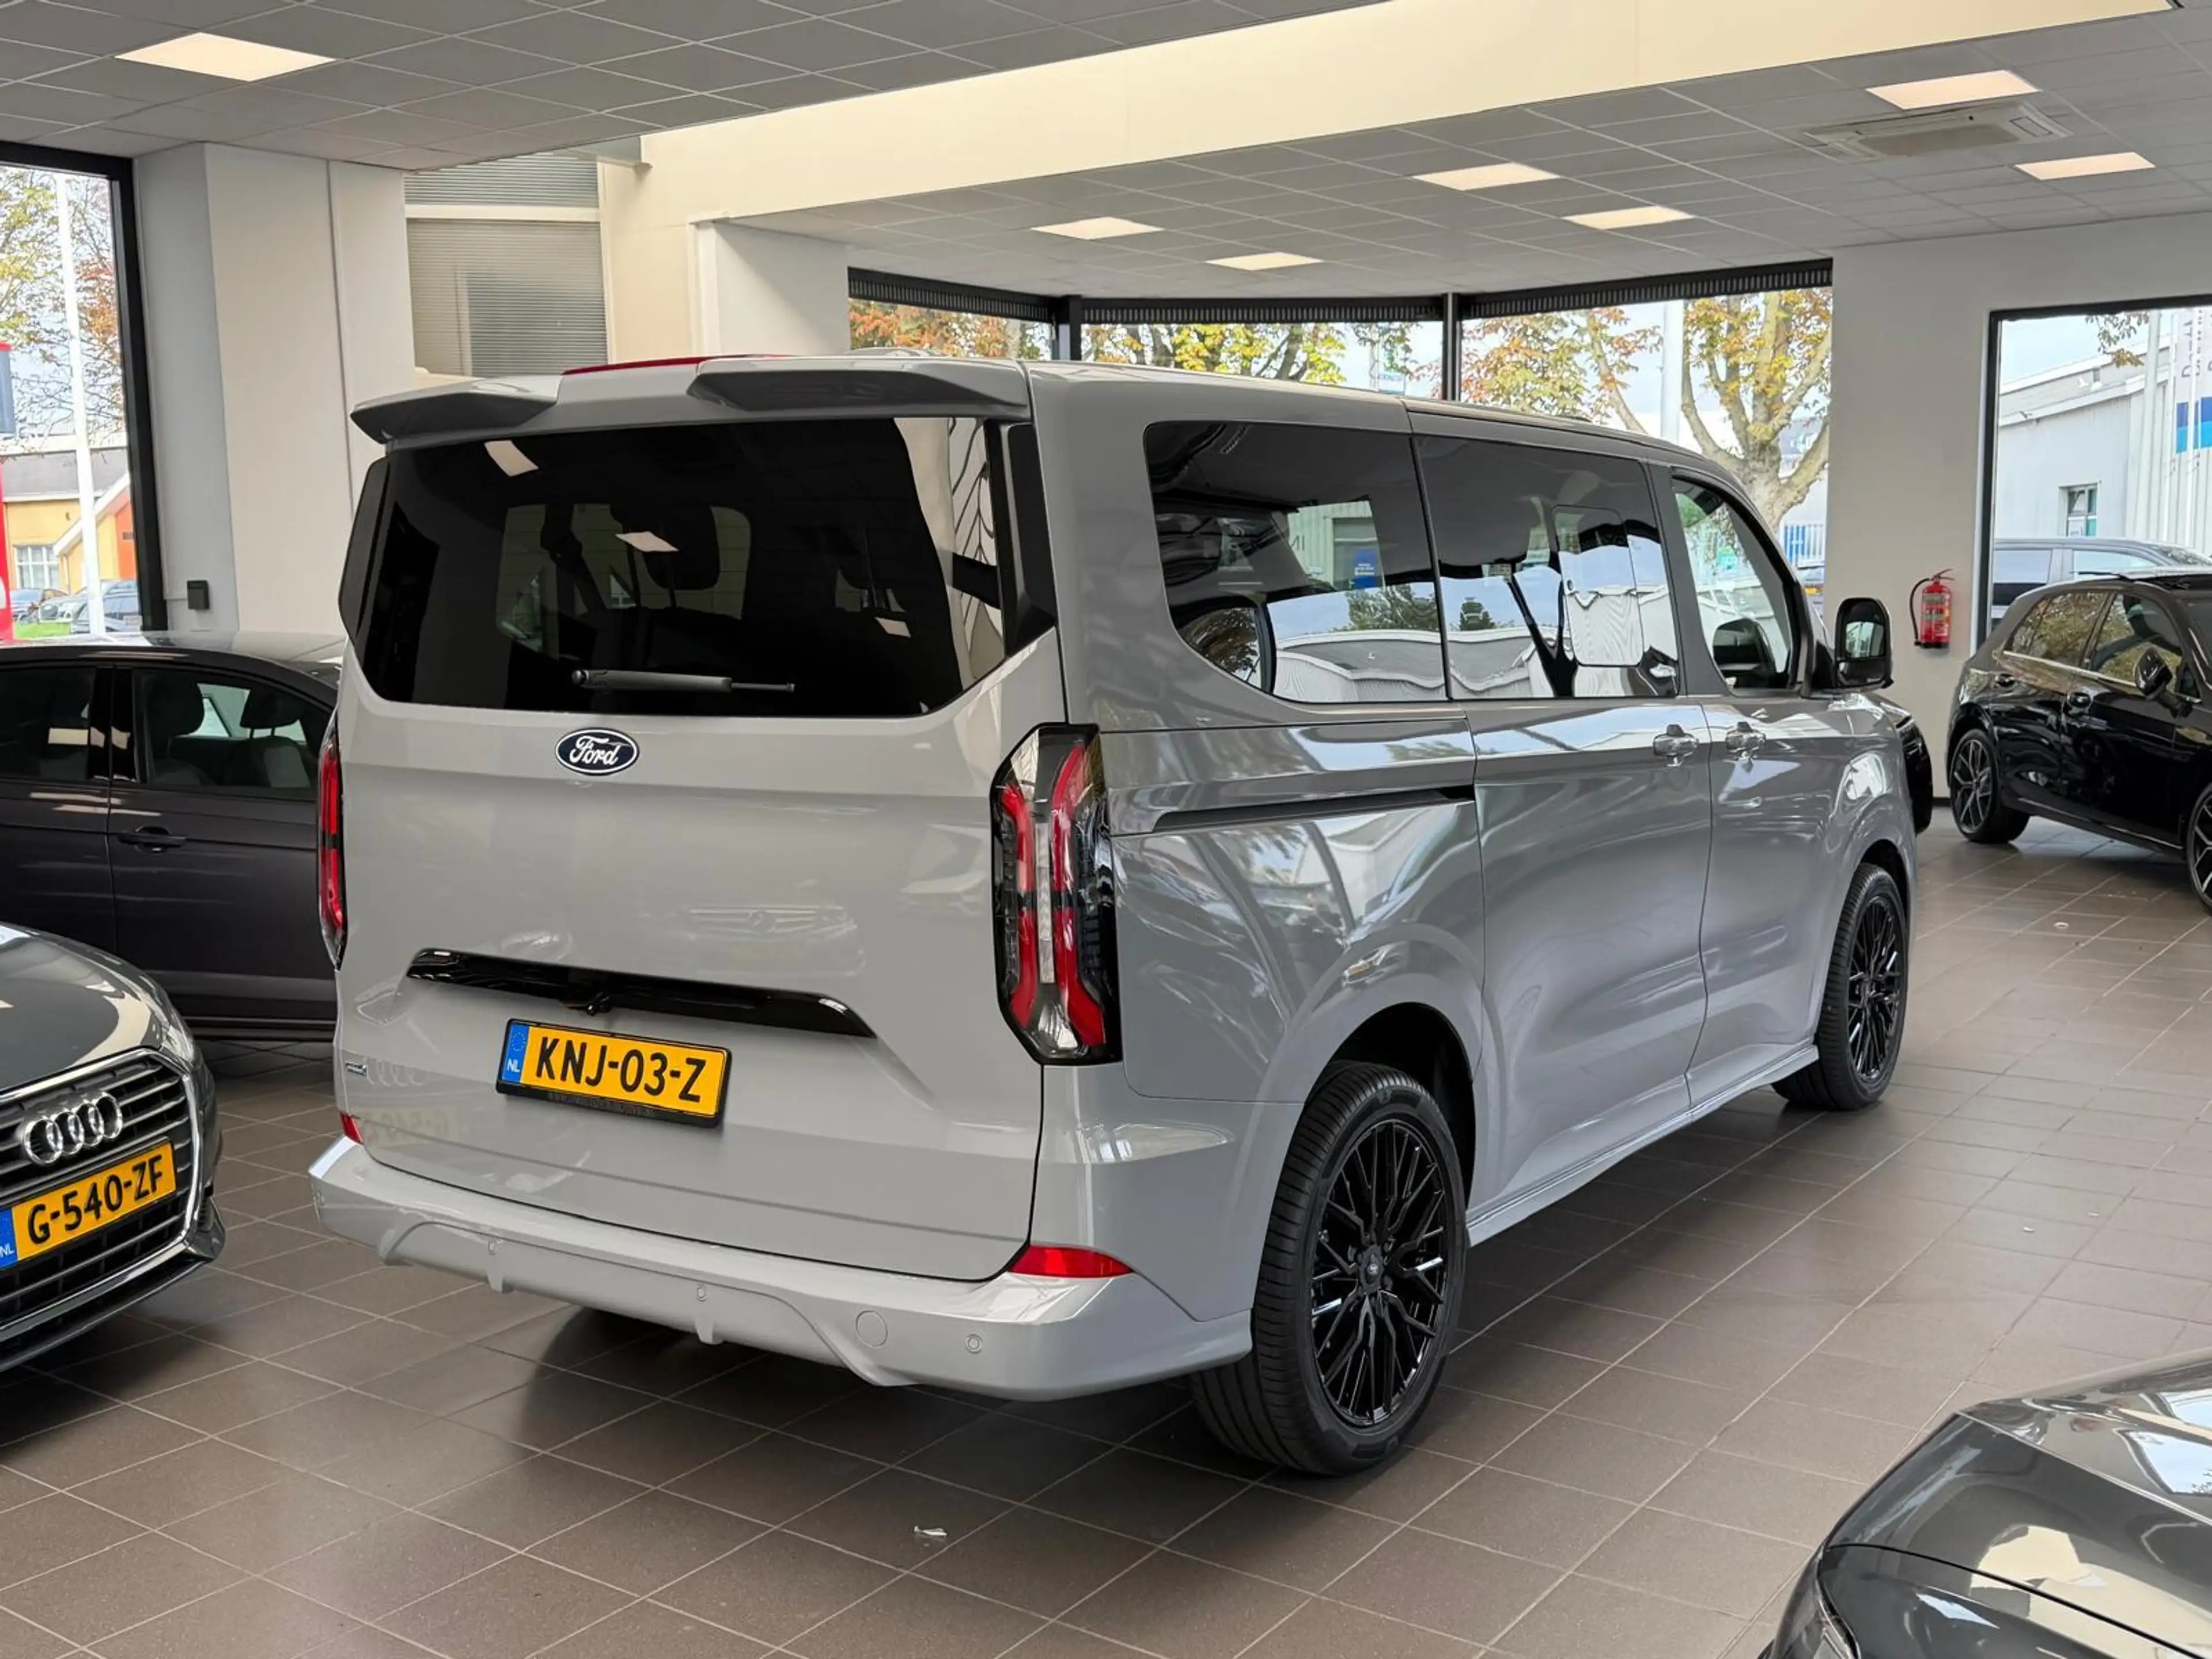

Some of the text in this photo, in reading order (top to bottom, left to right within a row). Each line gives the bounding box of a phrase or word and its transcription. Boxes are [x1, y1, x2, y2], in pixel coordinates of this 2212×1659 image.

[569, 734, 622, 766] Ford
[507, 1058, 521, 1073] NL
[536, 1036, 707, 1103] KNJ-03-Z
[28, 1154, 163, 1246] G-540-ZF
[0, 1242, 14, 1258] NL
